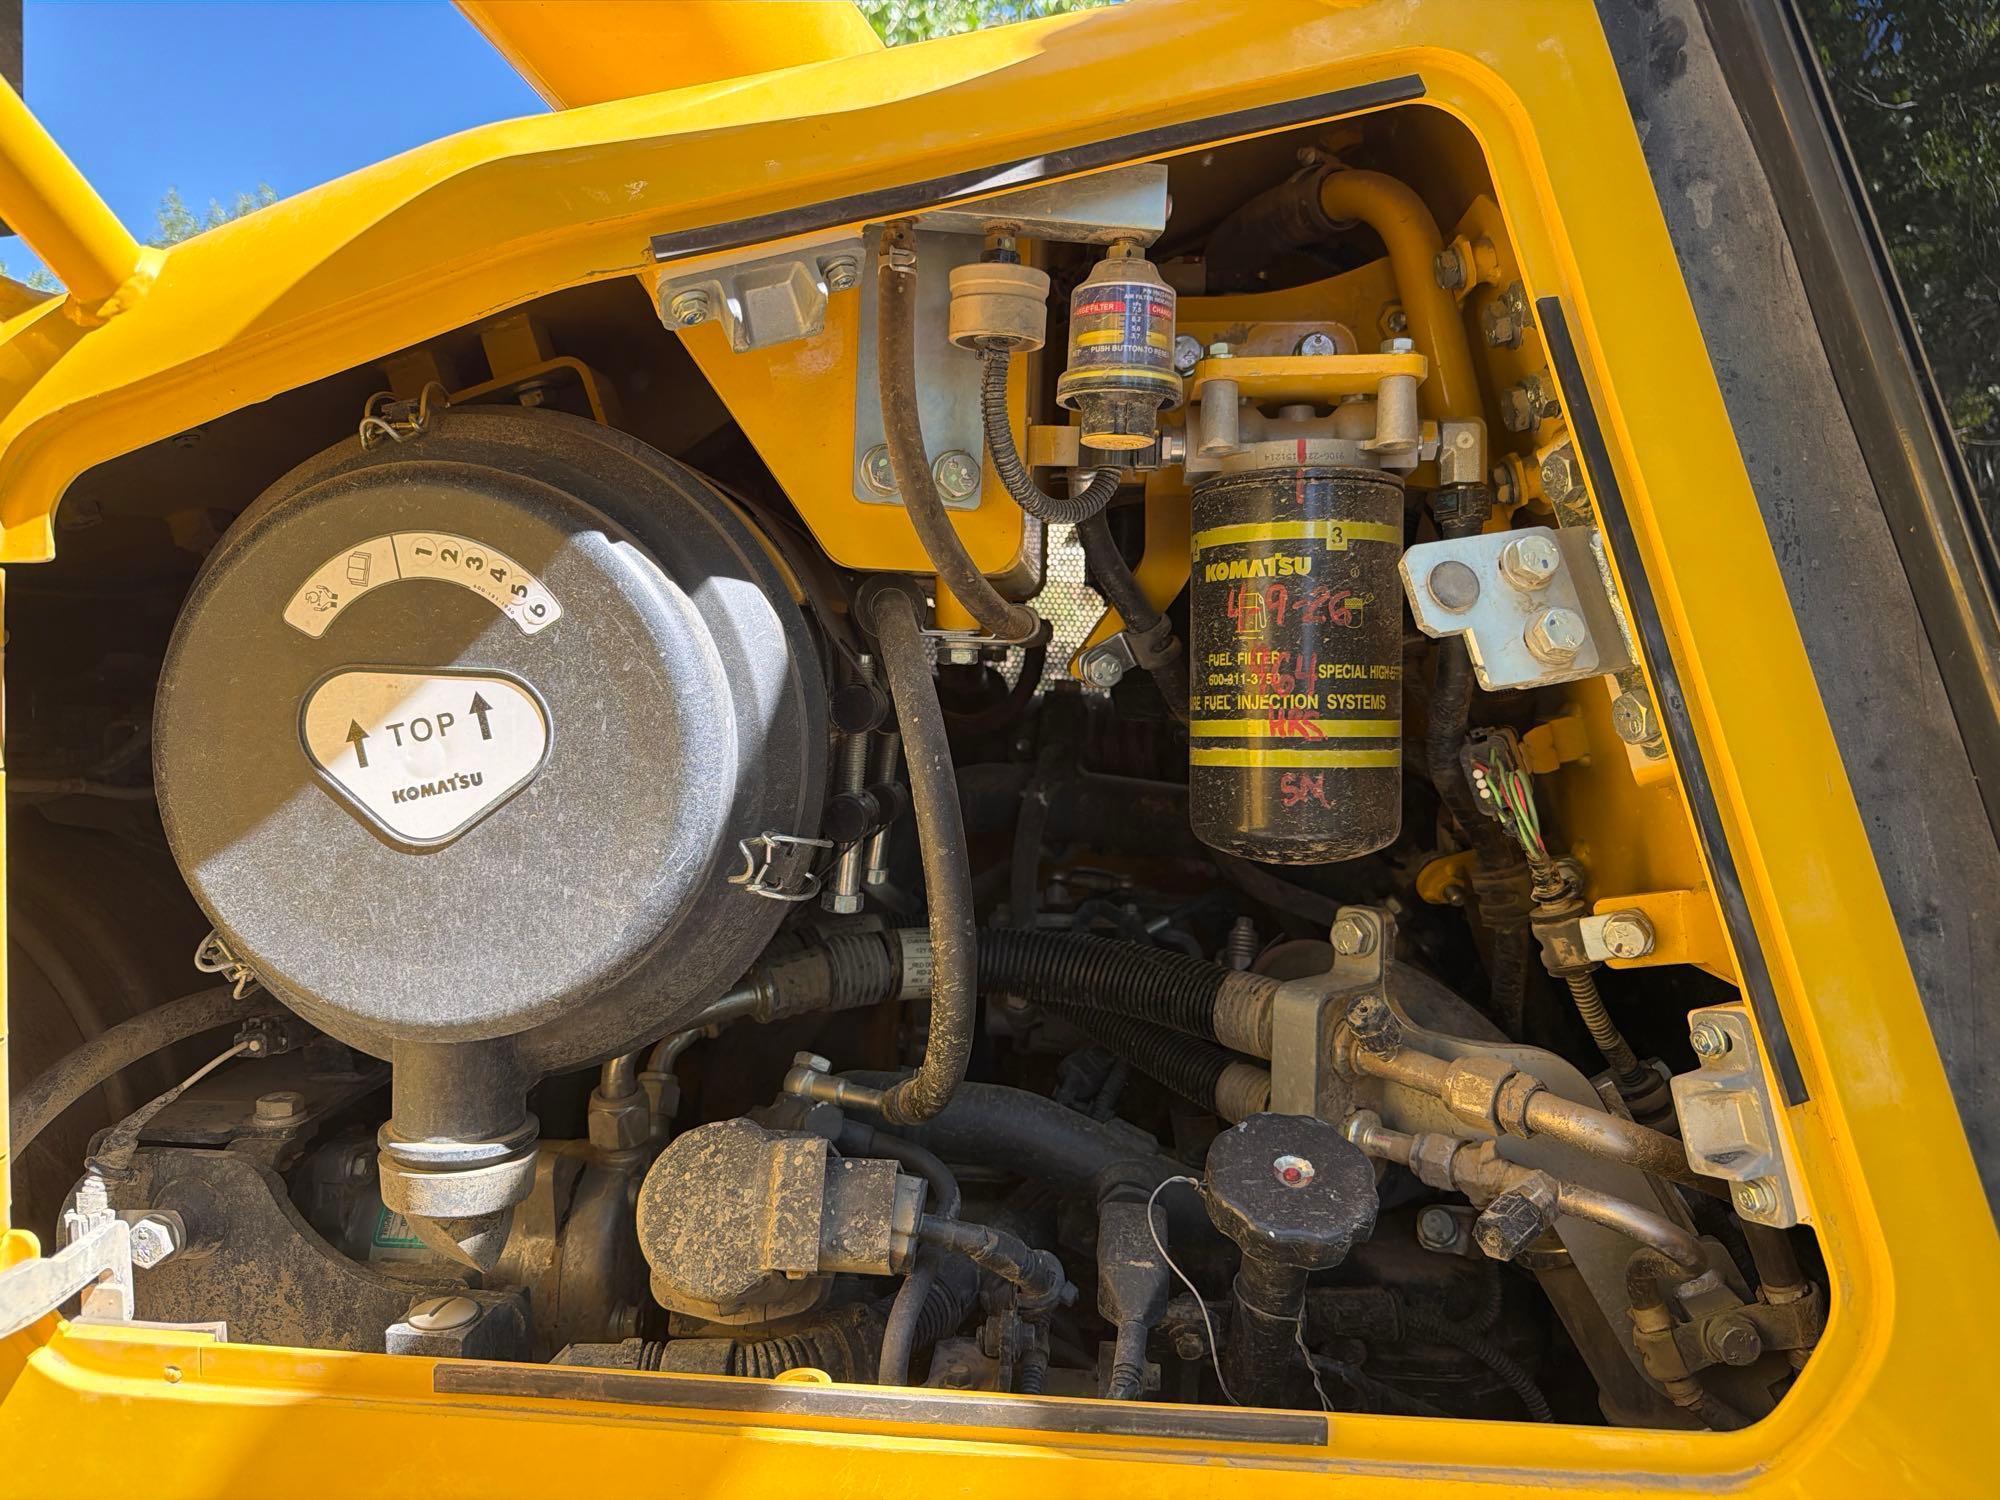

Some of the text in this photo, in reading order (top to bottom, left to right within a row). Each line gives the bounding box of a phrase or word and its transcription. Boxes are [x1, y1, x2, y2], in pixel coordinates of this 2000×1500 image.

[1090, 345, 1111, 353] PUSH
[1111, 343, 1143, 353] BUTTON
[1331, 526, 1343, 545] 3
[1205, 553, 1312, 583] KOMATSU
[414, 546, 546, 618] 1 2 3 4 5 6
[1208, 650, 1280, 667] FUEL FILTER
[1318, 663, 1368, 679] SPECIAL
[1204, 694, 1232, 711] FUEL
[1237, 693, 1319, 710] INJECTION
[1326, 693, 1387, 710] SYSTEMS
[385, 712, 455, 747] TOP
[391, 771, 483, 804] KOMATSU
